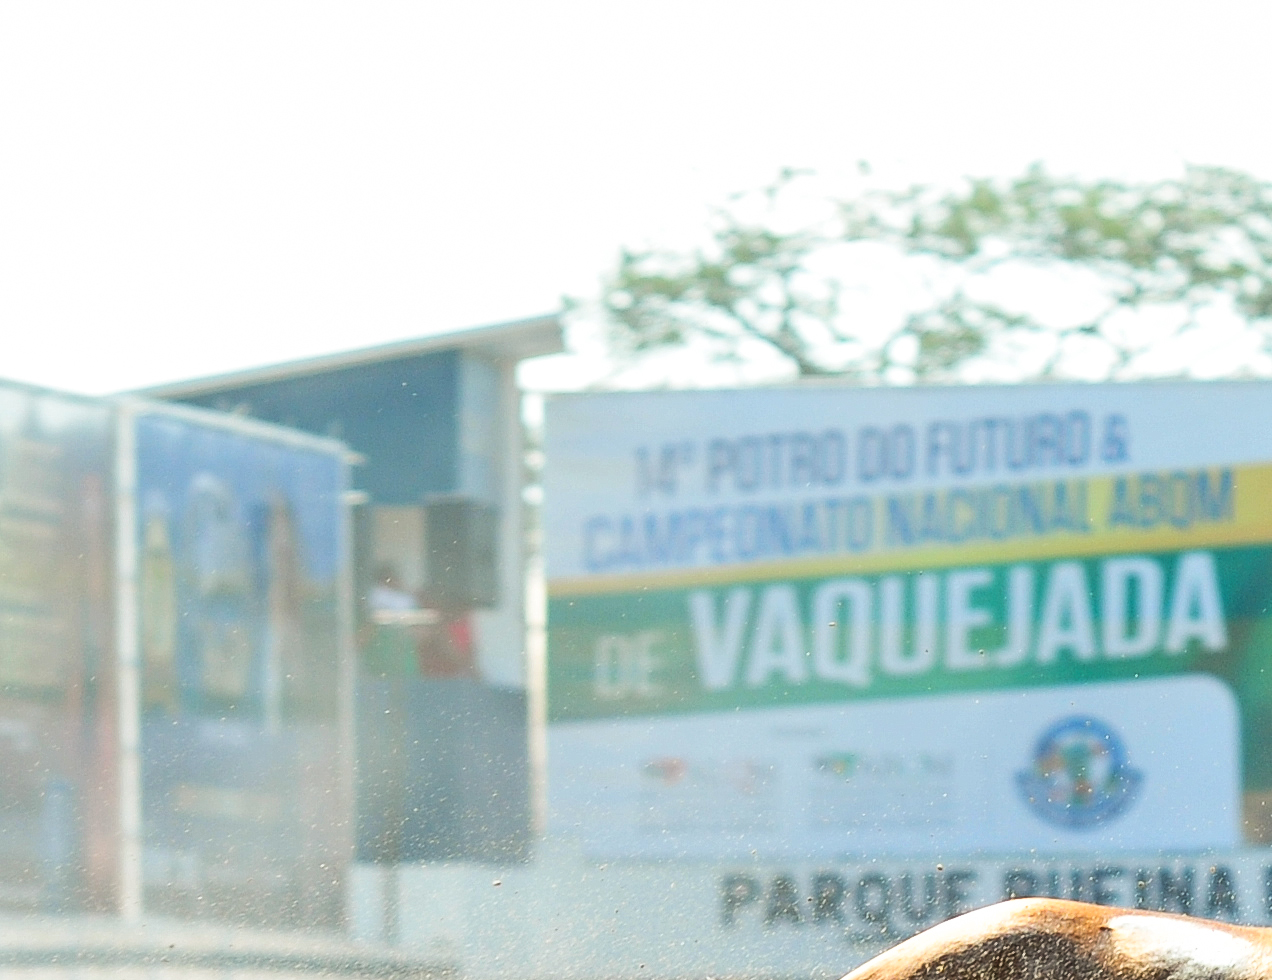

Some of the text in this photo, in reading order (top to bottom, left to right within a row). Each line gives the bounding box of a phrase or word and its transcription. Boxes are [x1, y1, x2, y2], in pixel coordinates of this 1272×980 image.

[704, 428, 846, 494] POTRO
[857, 422, 916, 484] DO
[924, 409, 1092, 475] FUTURO
[582, 468, 1236, 573] CAMPEONATO NACIONAL ABQM
[594, 550, 1229, 700] DE VAQUEJADA
